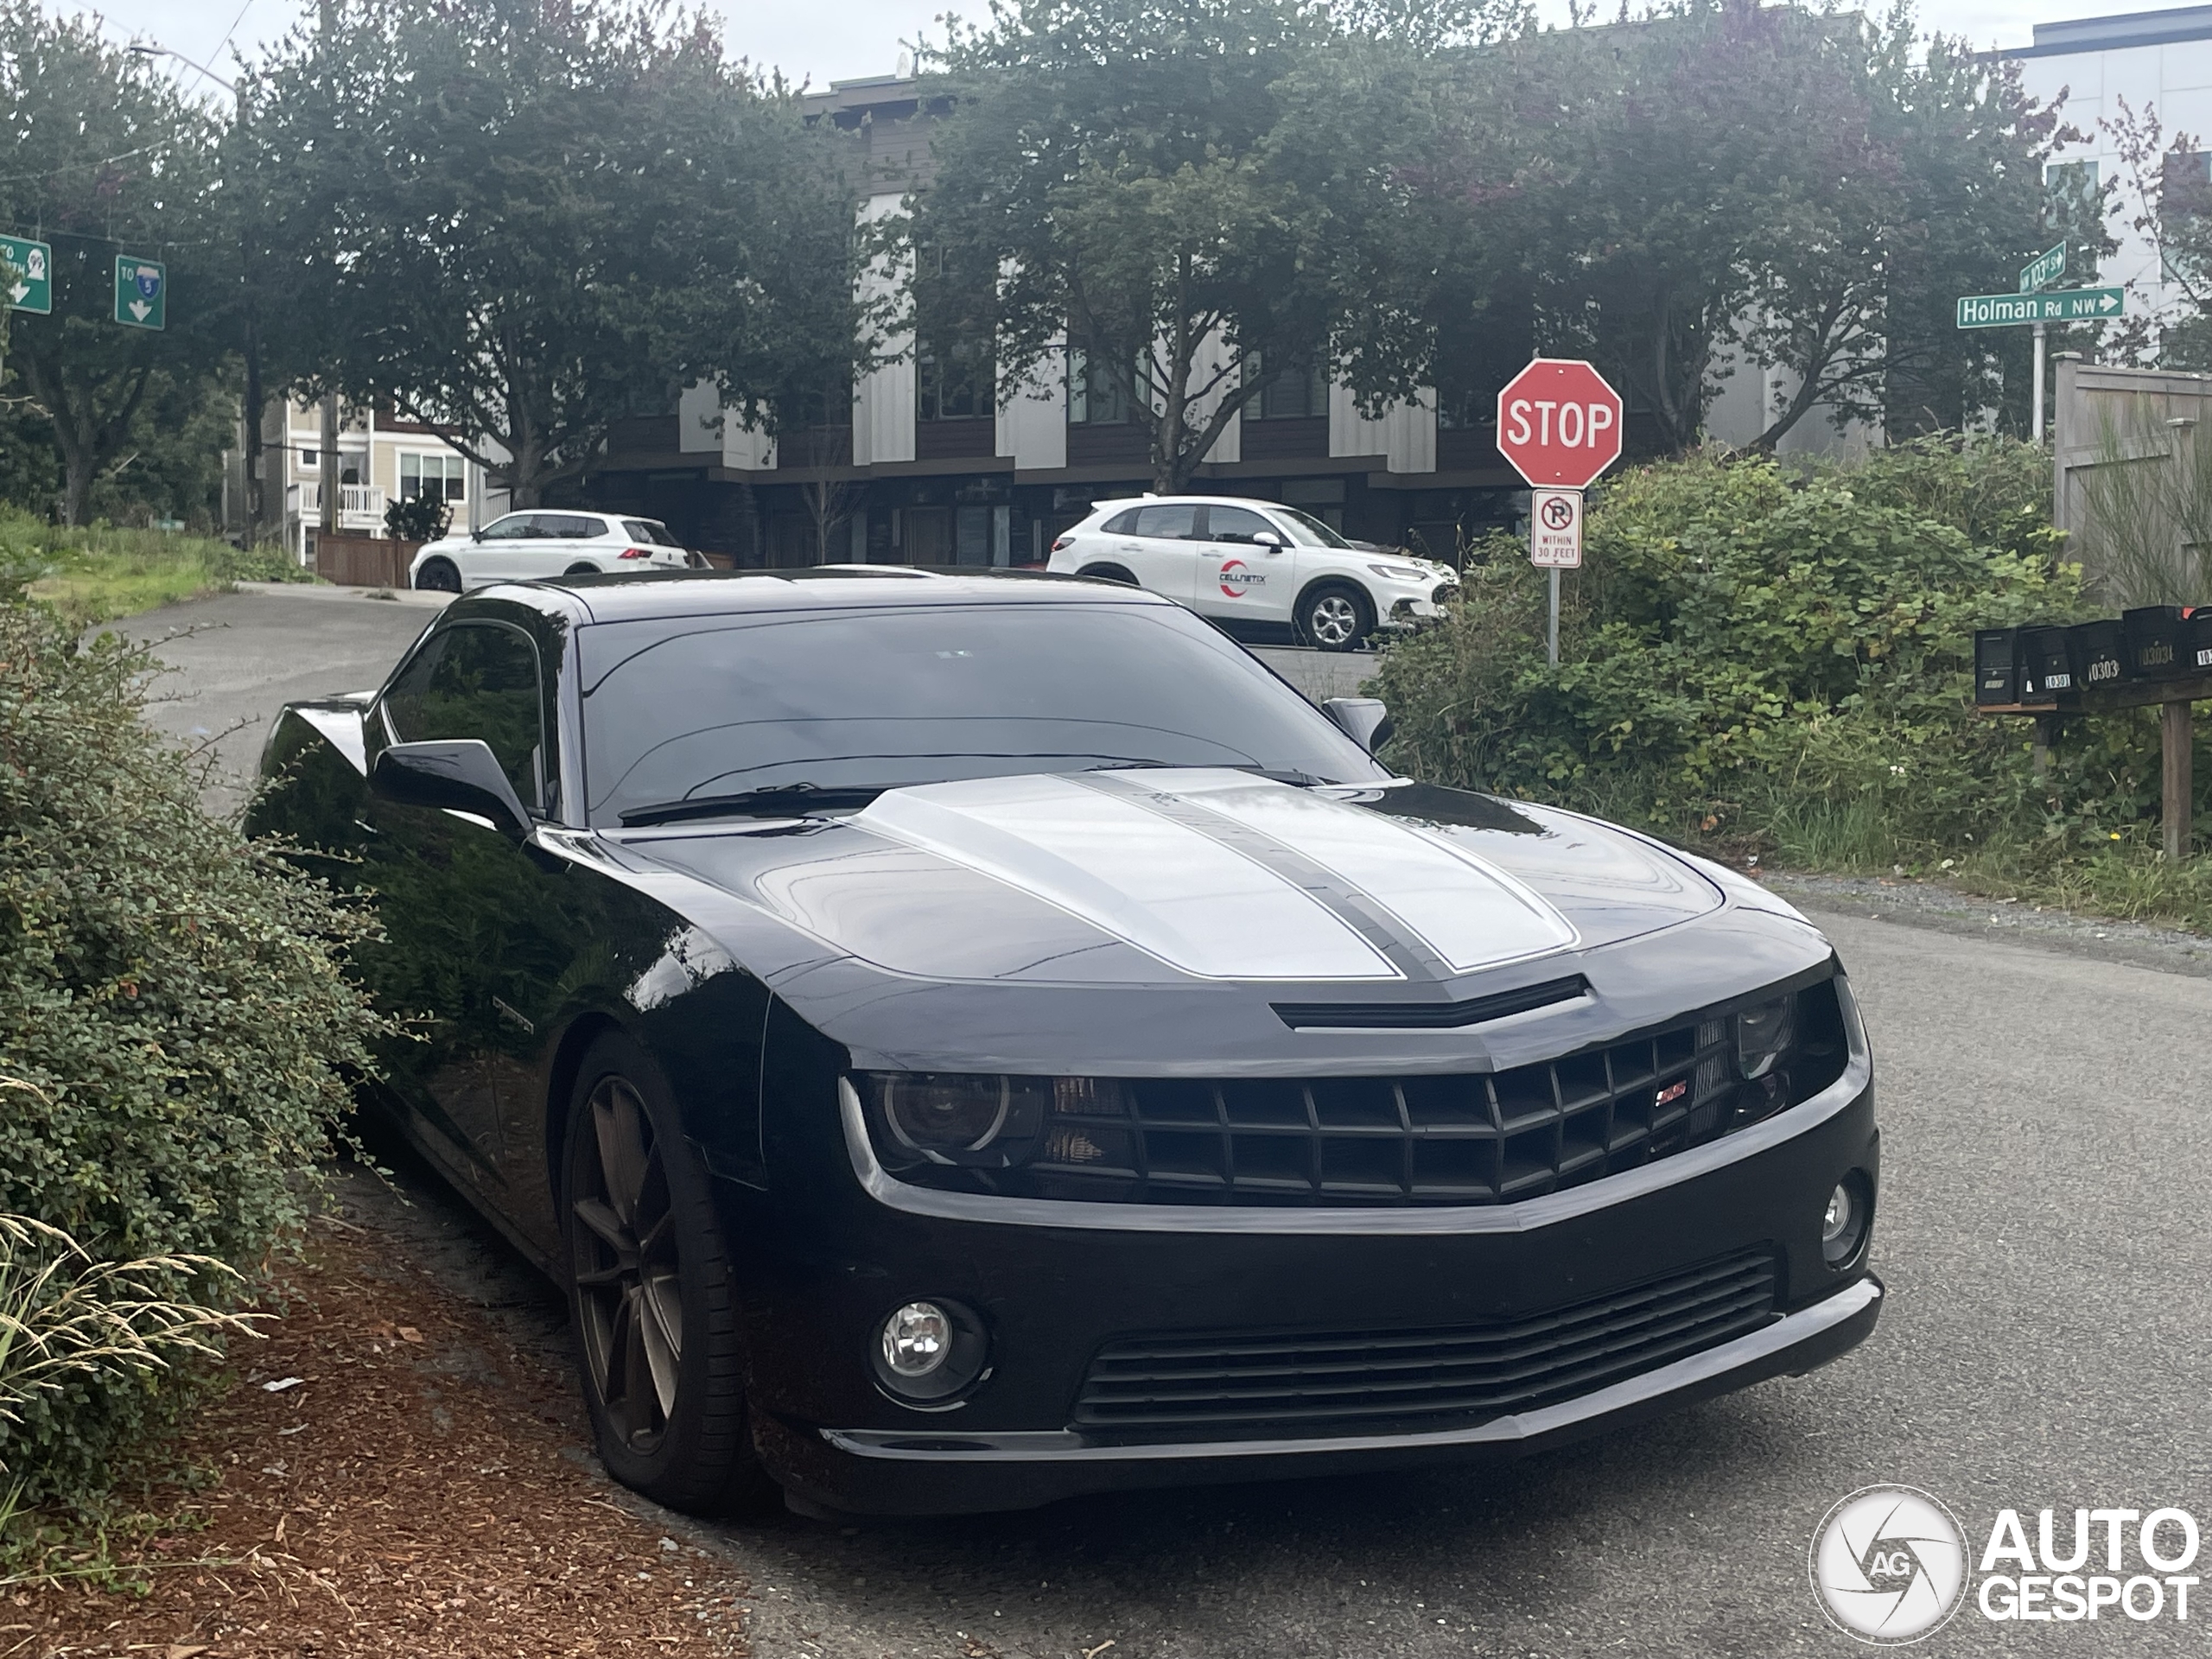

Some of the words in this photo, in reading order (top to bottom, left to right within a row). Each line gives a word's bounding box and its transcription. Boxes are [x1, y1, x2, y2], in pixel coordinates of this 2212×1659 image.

[120, 265, 135, 282] TO
[144, 279, 153, 295] 5
[1962, 299, 2038, 322] Holman
[2044, 301, 2063, 317] Rd
[2071, 298, 2097, 315] NW
[1506, 398, 1614, 448] STOP
[1541, 535, 1573, 546] WITHIN
[1537, 547, 1550, 558] 30
[1553, 548, 1576, 559] FEET
